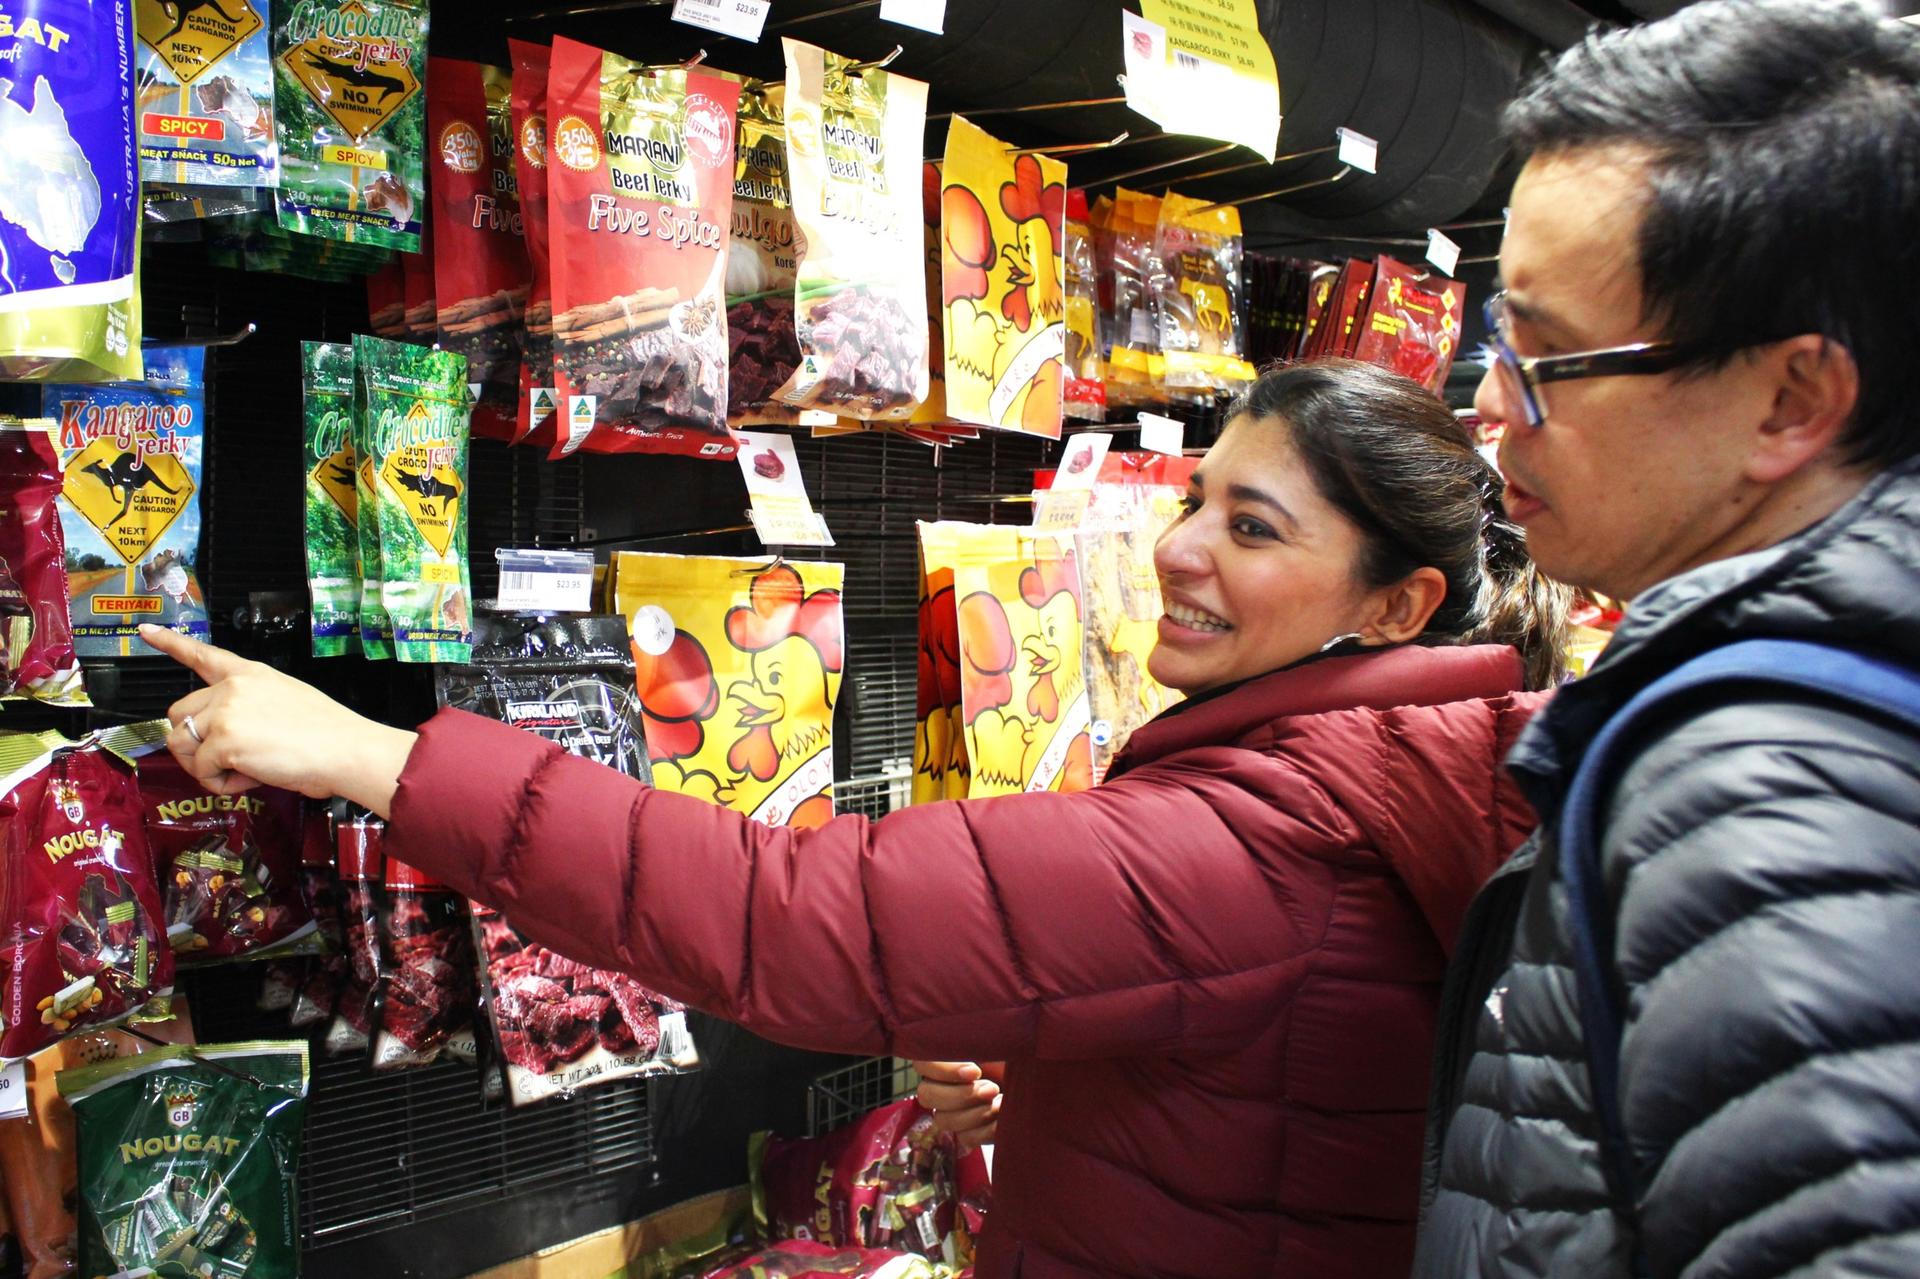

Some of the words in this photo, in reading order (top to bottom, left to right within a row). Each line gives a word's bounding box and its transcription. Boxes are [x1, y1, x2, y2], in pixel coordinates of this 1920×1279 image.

[736, 3, 759, 16] $23.95
[187, 14, 236, 34] CAUTION
[288, 1, 416, 44] Crocodile
[115, 1, 128, 81] NUMBER
[188, 23, 236, 42] KANGAROO
[171, 42, 203, 55] NEXT
[1168, 36, 1211, 55] KANGAROO
[171, 54, 202, 65] 10km
[342, 87, 369, 104] NO
[329, 100, 383, 116] SWIMMING
[160, 118, 209, 135] SPICY
[122, 86, 134, 211] AUSTRALIA'S
[608, 132, 684, 170] MARIANI
[140, 148, 169, 159] MEAT
[171, 150, 208, 161] SNACK
[213, 153, 237, 167] 50g
[336, 150, 375, 166] SPICY
[611, 167, 650, 192] Beef
[653, 173, 692, 202] Jerky
[733, 180, 756, 198] eef
[311, 208, 336, 218] DRIED
[337, 212, 361, 221] MEAT
[362, 215, 389, 226] SNACK
[473, 194, 524, 236] Five
[588, 193, 651, 236] Five
[656, 204, 721, 251] Spice
[774, 246, 796, 268] Kore
[60, 400, 193, 450] Kangaroo
[376, 405, 461, 458] Crocodile
[404, 446, 427, 457] CAUTI
[133, 495, 177, 506] CAUTION
[133, 505, 176, 514] KANGAROO
[418, 502, 437, 517] NO
[416, 516, 449, 527] SWIMMING
[118, 526, 147, 536] NEXT
[118, 536, 147, 547] 10km
[431, 567, 454, 580] SPICY
[556, 580, 581, 589] $23.95
[97, 599, 158, 610] TERIYAKI
[89, 627, 113, 636] MEAT
[116, 627, 141, 636] SNAC
[509, 703, 578, 720] KIRKLAND
[513, 717, 579, 729] Signature
[595, 734, 612, 745] BEEF
[67, 805, 81, 819] GB
[156, 794, 265, 822] NOUGAT
[43, 829, 126, 865] NOUGAT
[12, 975, 22, 1026] GOLDEN
[568, 1068, 583, 1081] WT
[173, 1110, 190, 1122] GB
[119, 1134, 241, 1165] NOUGAT
[815, 1161, 835, 1250] UGAT
